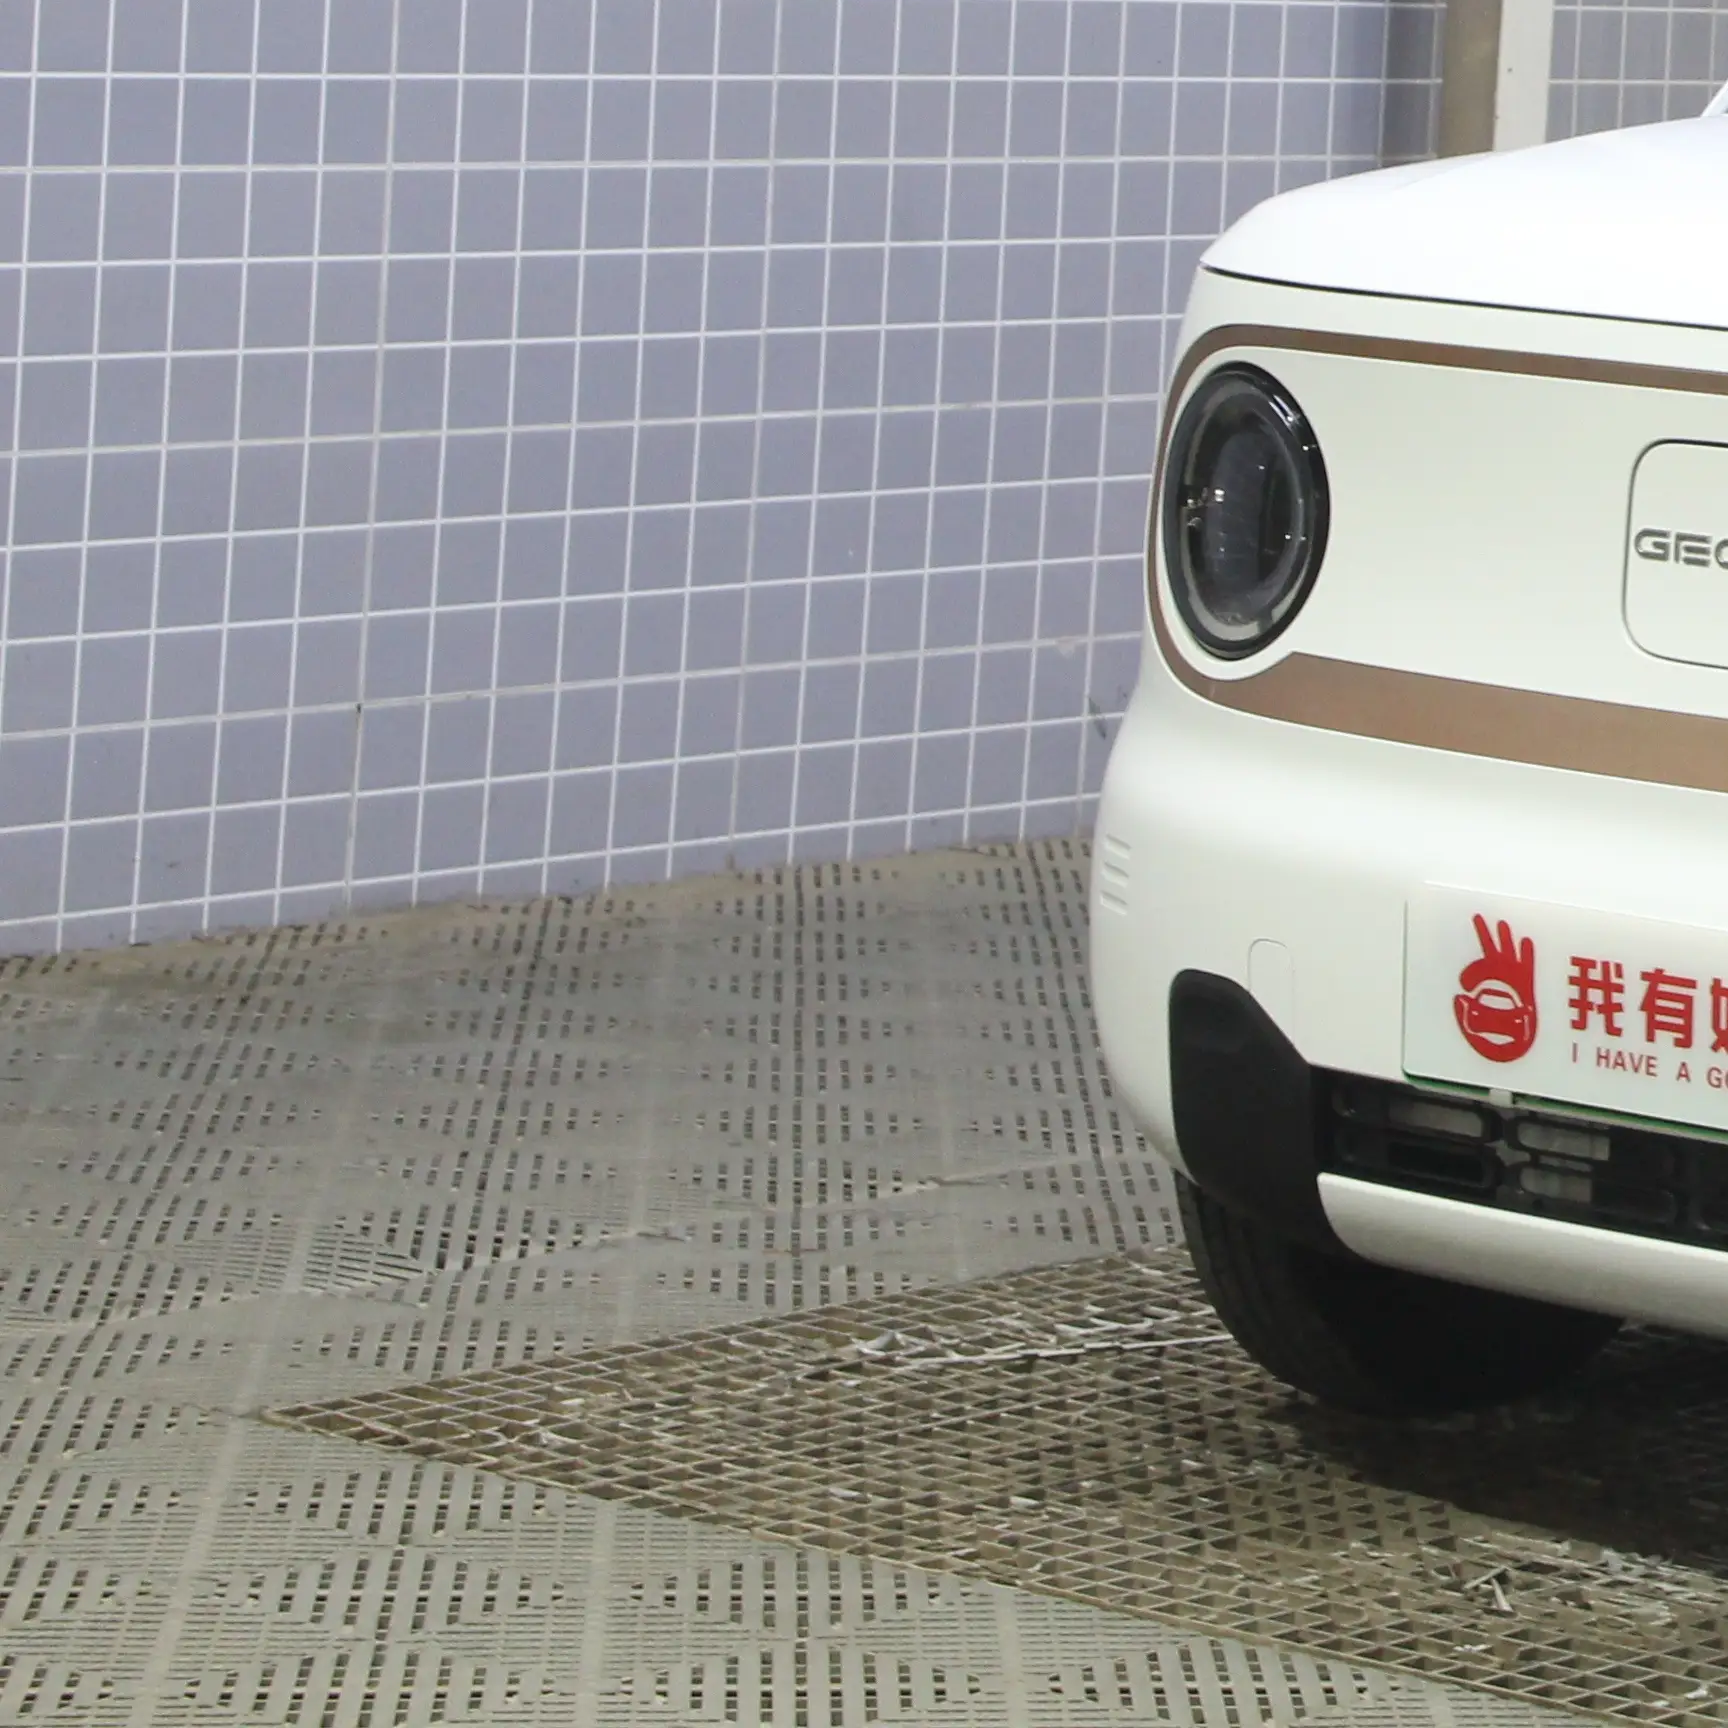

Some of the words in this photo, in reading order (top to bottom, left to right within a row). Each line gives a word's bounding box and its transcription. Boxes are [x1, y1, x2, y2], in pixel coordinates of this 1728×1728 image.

[1571, 1042, 1578, 1063] I
[1596, 1046, 1657, 1078] HAVE
[1675, 1062, 1692, 1083] A
